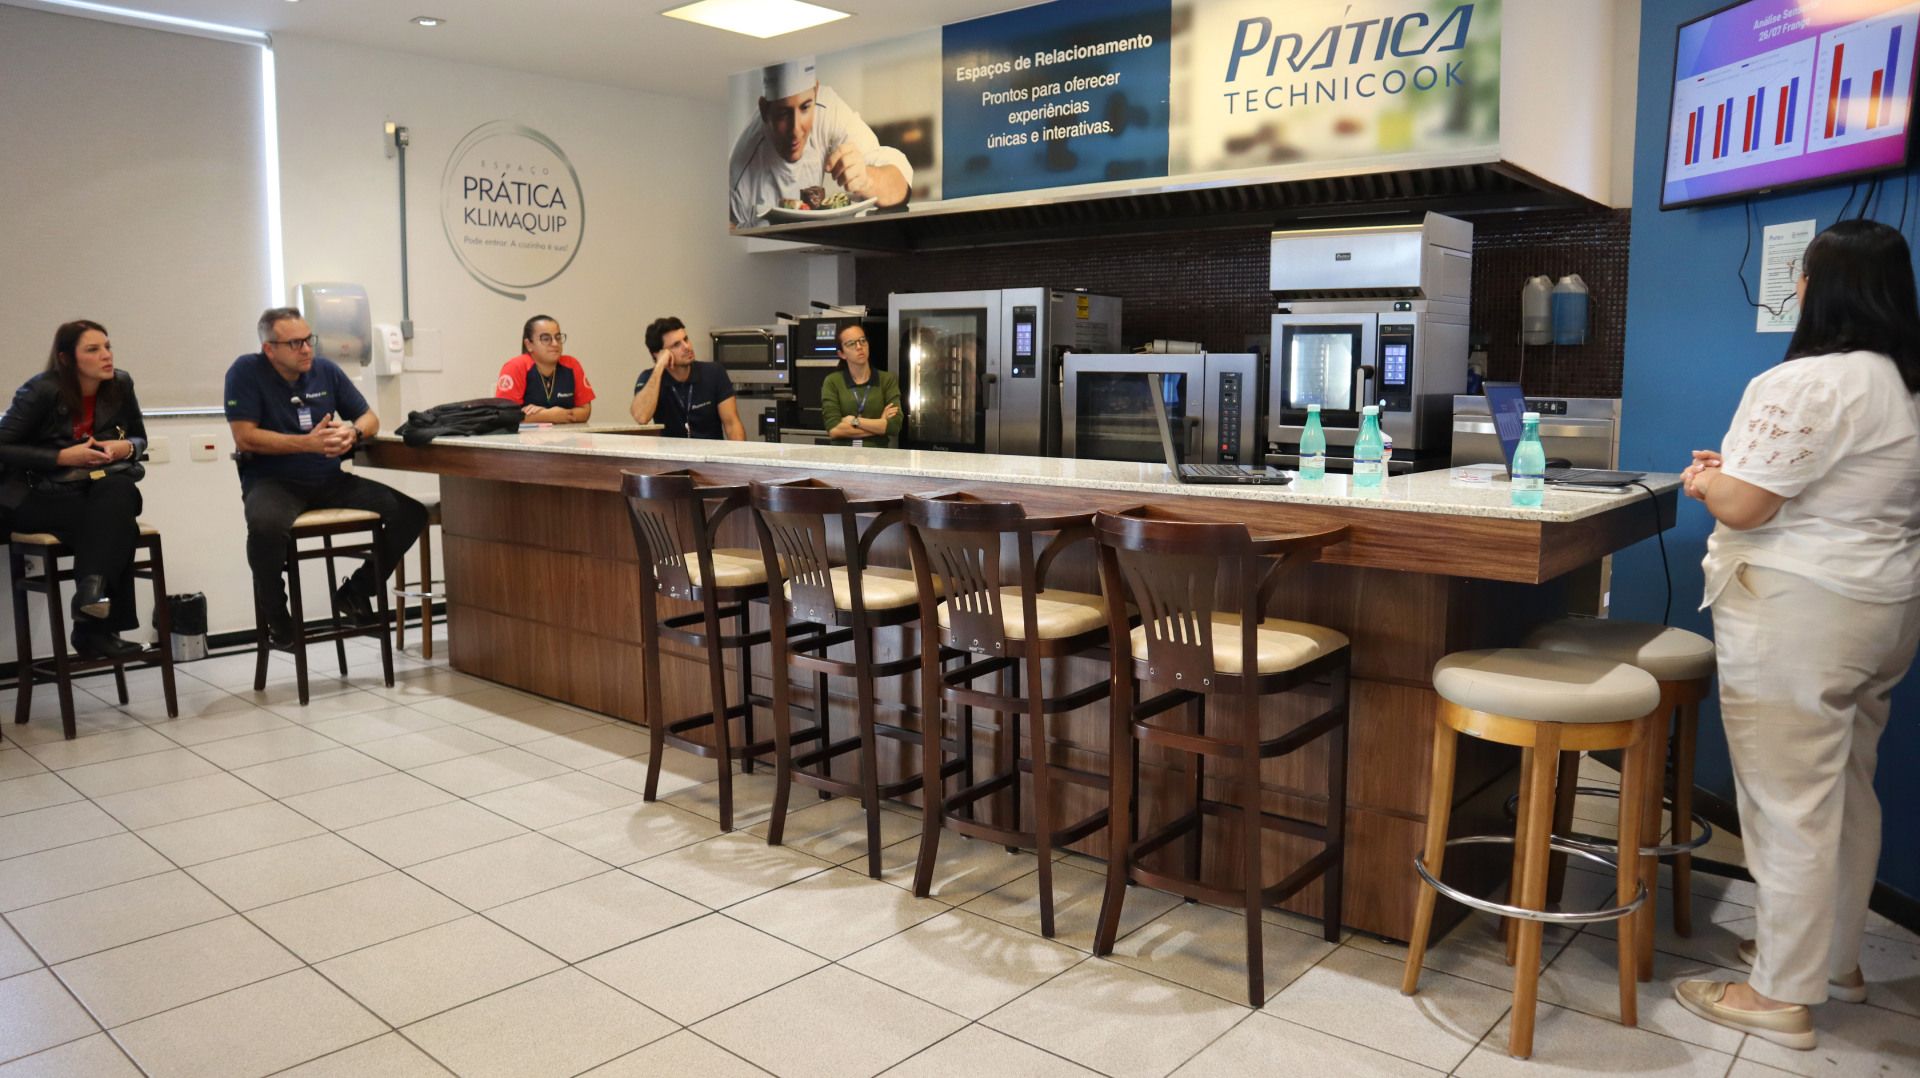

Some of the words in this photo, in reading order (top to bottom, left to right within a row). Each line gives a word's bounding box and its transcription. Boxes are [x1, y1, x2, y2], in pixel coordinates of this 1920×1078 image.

[956, 60, 1011, 82] Espaços
[1014, 56, 1031, 71] de
[1035, 34, 1153, 68] Relacionamento
[982, 87, 1028, 106] Prontos
[1031, 82, 1061, 102] para
[1064, 71, 1121, 93] oferecer
[1223, 60, 1466, 115] TECHNICOOK
[1008, 99, 1090, 126] experiências
[987, 131, 1028, 149] únicas
[1030, 130, 1040, 143] e
[1042, 119, 1114, 141] interativas.
[481, 160, 550, 176] ESPAÇO
[464, 172, 567, 210] PRÁTICA
[464, 207, 567, 235] KLIMAQUIP
